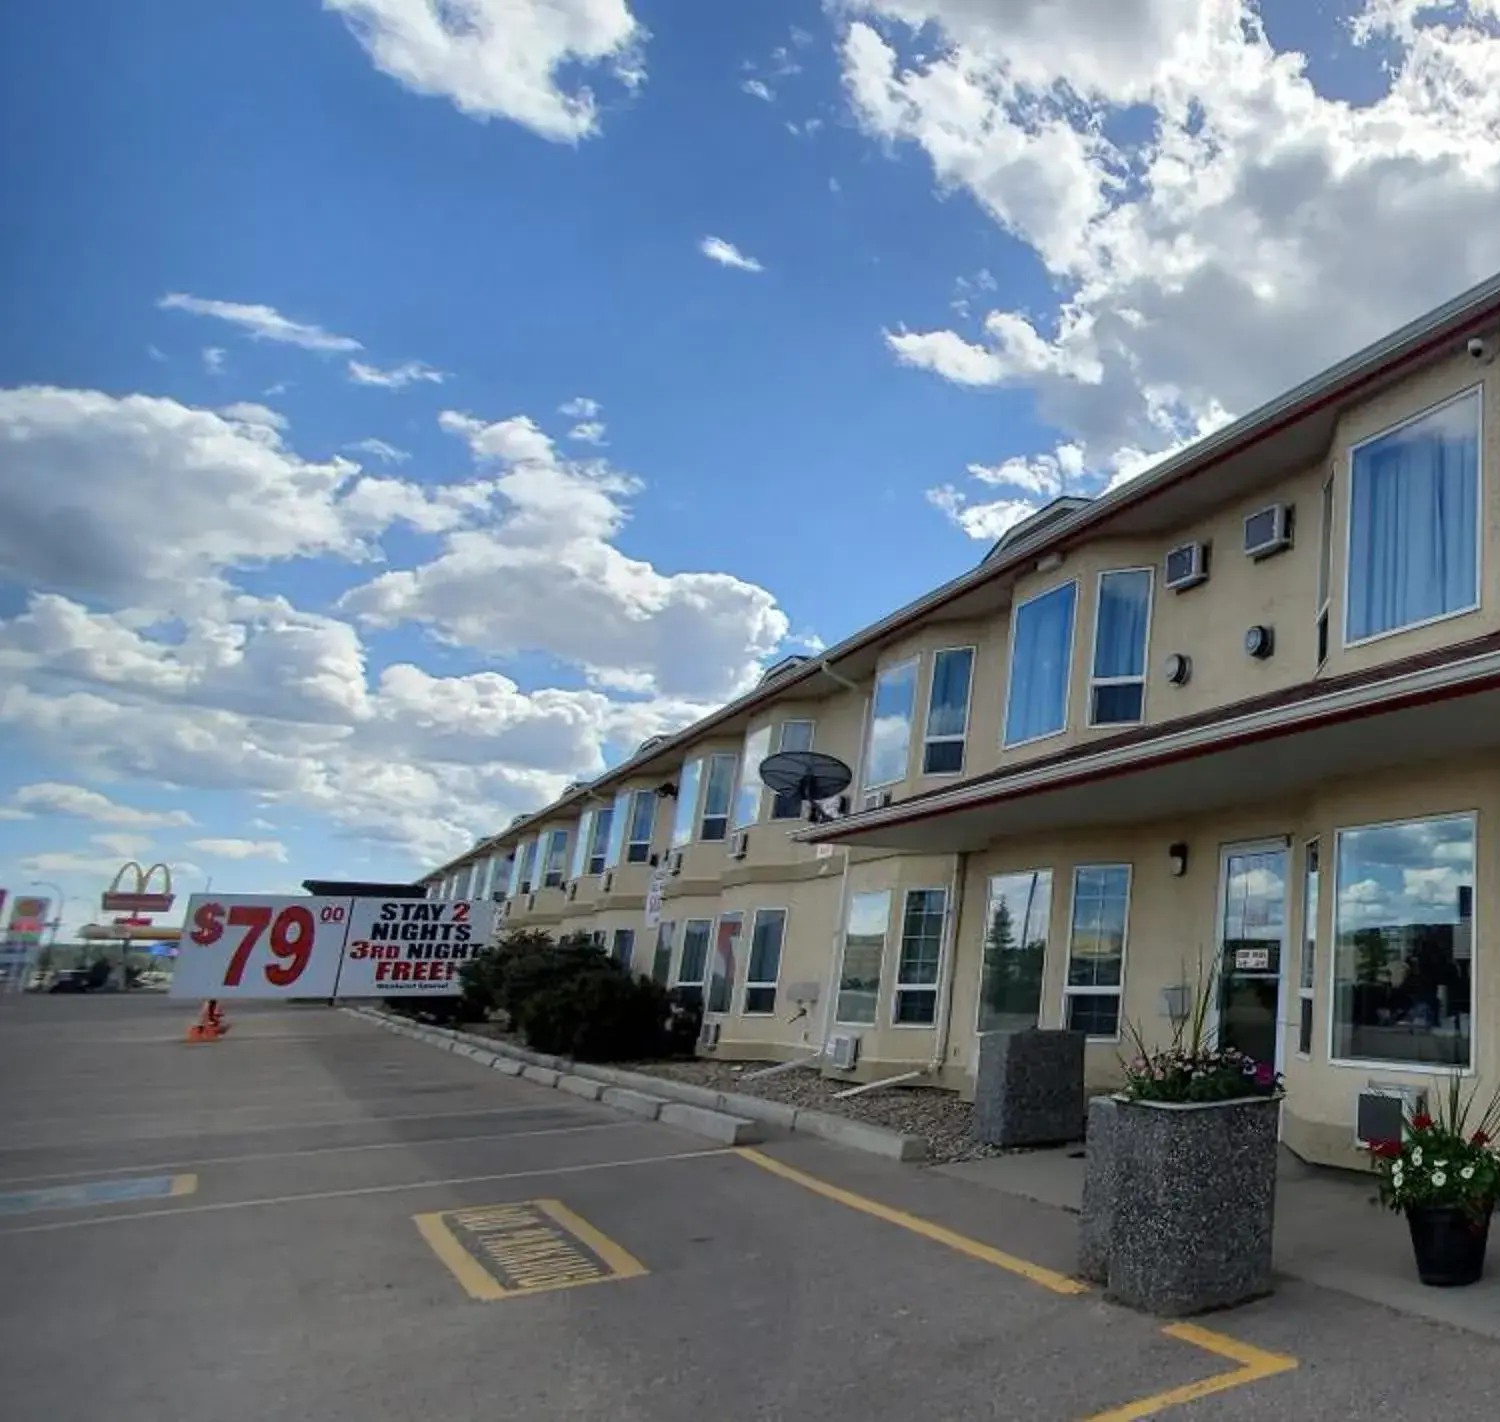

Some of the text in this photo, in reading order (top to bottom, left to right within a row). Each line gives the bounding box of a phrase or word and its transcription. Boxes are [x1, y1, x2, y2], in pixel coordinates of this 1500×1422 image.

[380, 901, 471, 923] STAY 2
[370, 923, 473, 941] NIGHTS
[190, 902, 316, 987] $79
[349, 940, 485, 960] 3RD NIGHT
